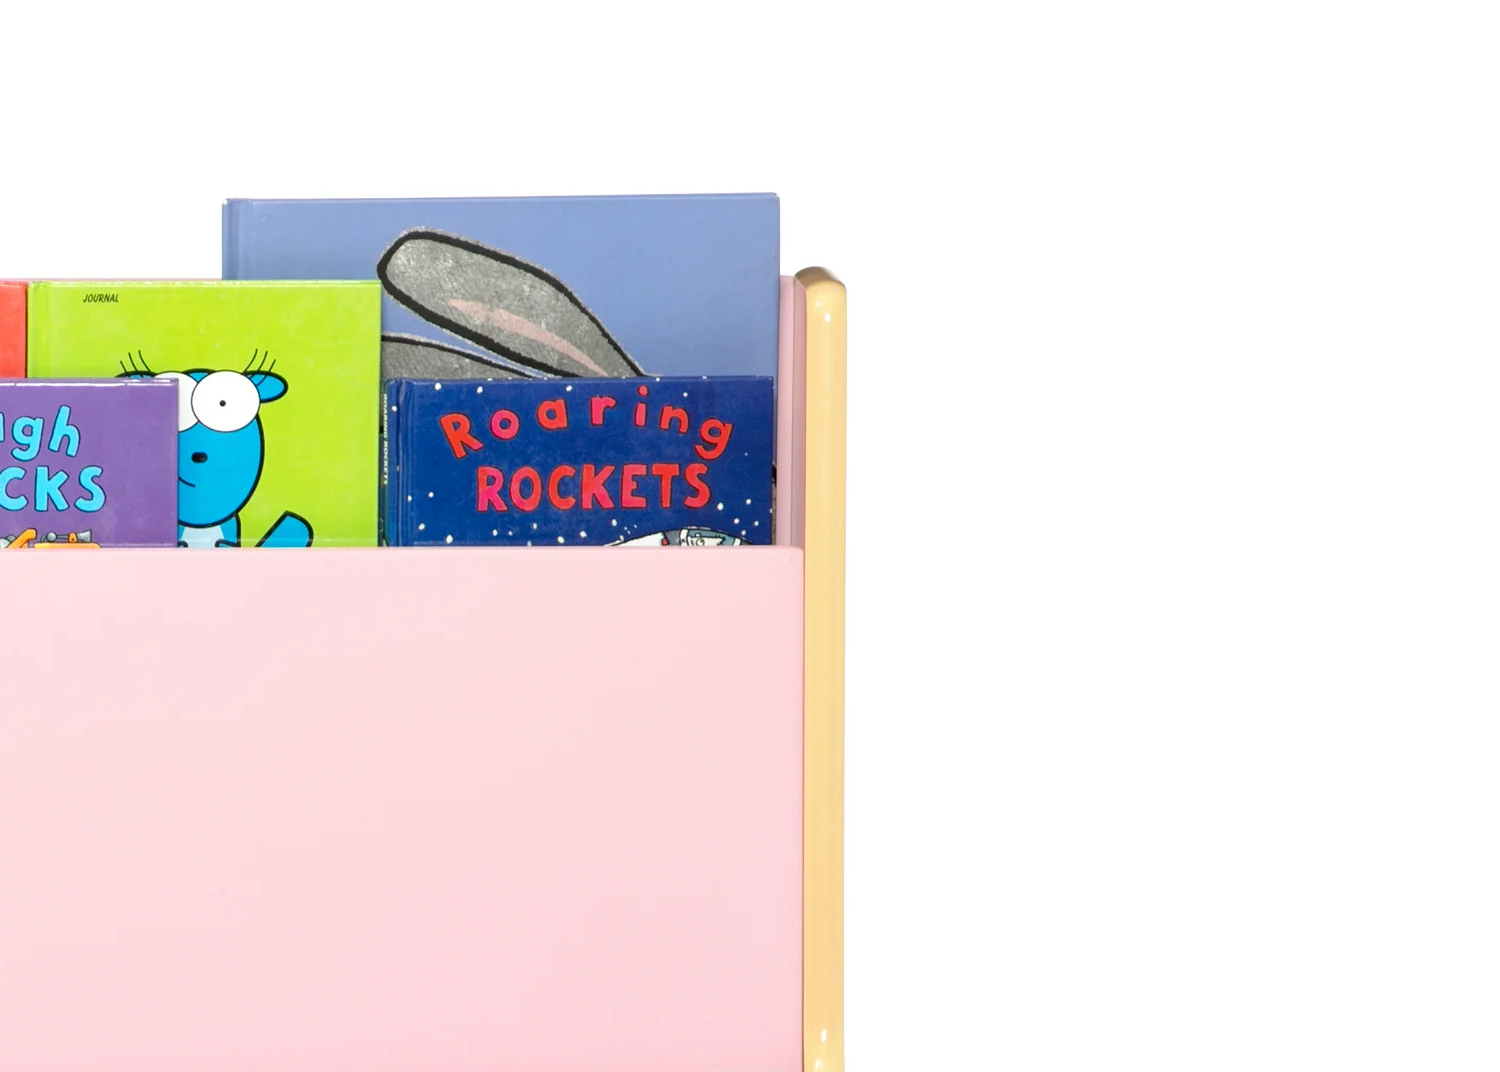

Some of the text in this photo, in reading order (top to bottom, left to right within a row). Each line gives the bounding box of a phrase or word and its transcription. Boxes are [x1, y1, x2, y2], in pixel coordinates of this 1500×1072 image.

[82, 293, 119, 304] JOURNAL
[438, 384, 734, 461] Roaring
[477, 462, 713, 513] ROCKETS
